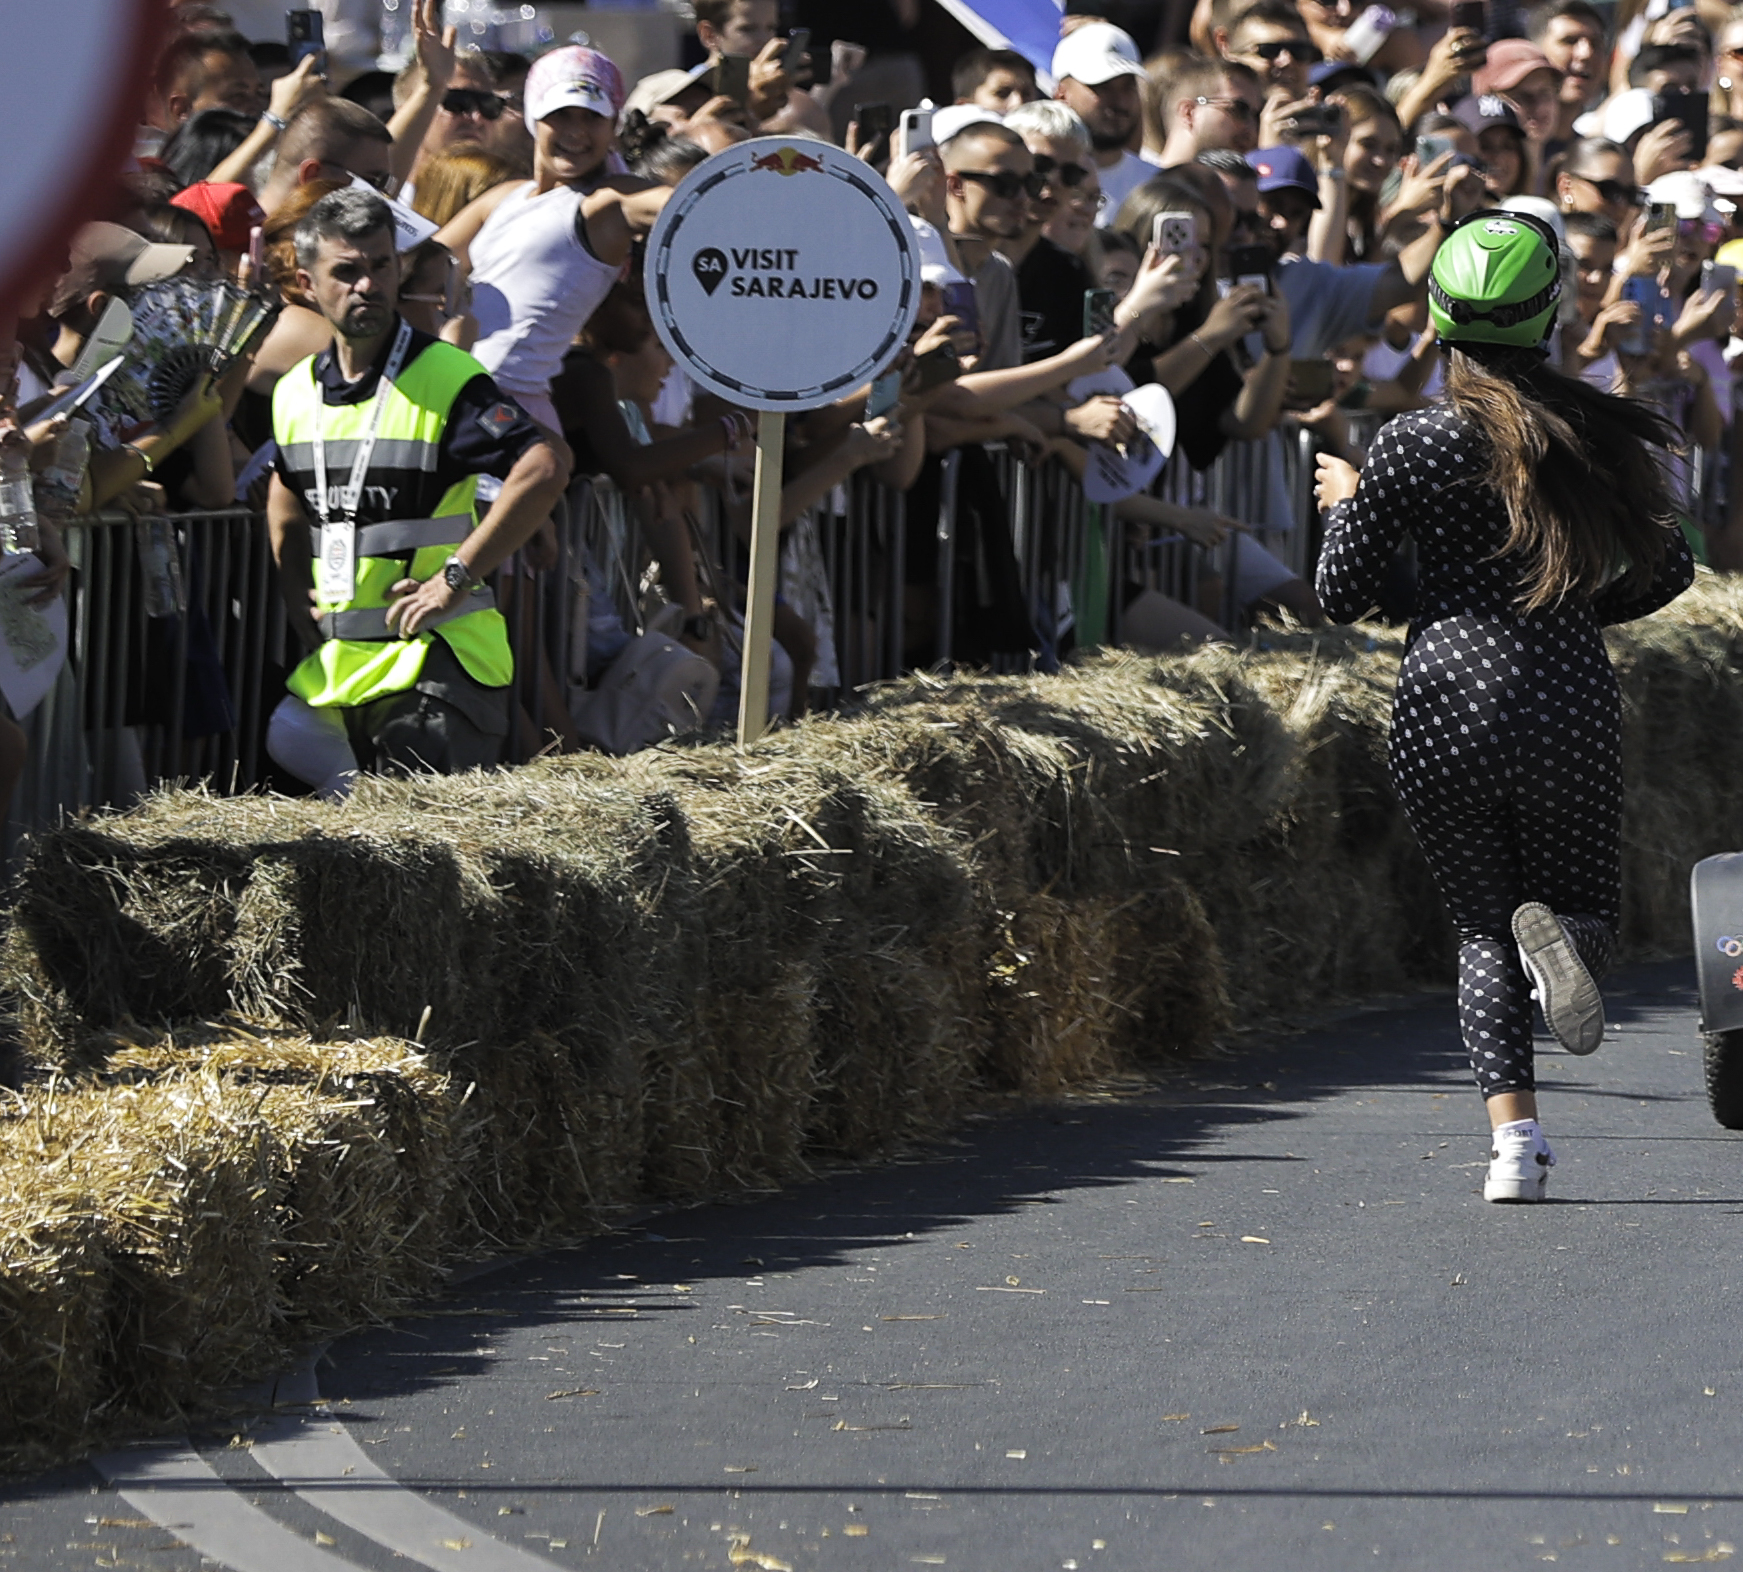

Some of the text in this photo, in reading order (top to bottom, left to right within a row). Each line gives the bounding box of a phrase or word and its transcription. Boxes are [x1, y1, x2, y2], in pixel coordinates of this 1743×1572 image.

[697, 257, 723, 273] SA
[730, 247, 799, 270] VISIT
[730, 276, 879, 300] SARAJEVO
